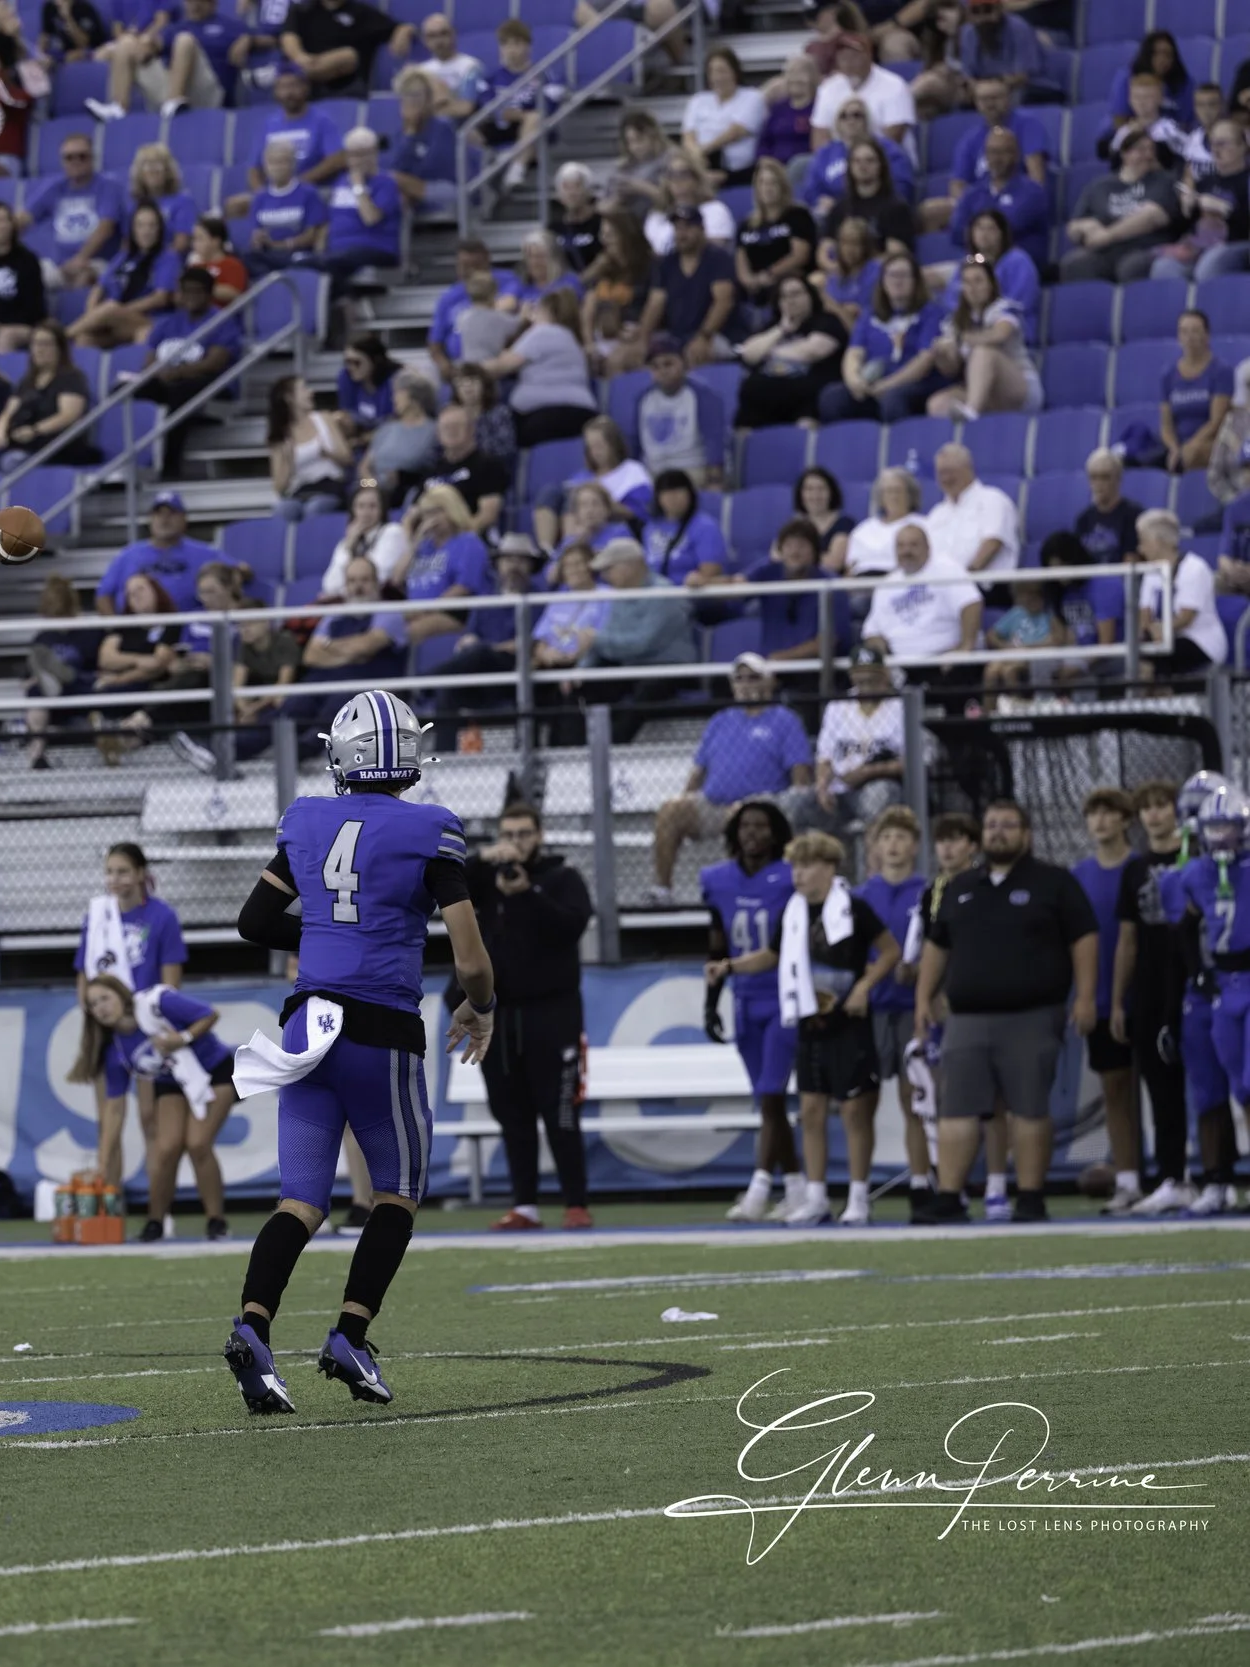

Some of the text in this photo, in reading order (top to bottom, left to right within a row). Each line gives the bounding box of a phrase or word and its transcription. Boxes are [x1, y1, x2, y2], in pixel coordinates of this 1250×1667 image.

[359, 769, 415, 779] HARD WAY
[323, 820, 364, 924] 4
[731, 907, 770, 955] 41
[317, 1012, 336, 1034] UK
